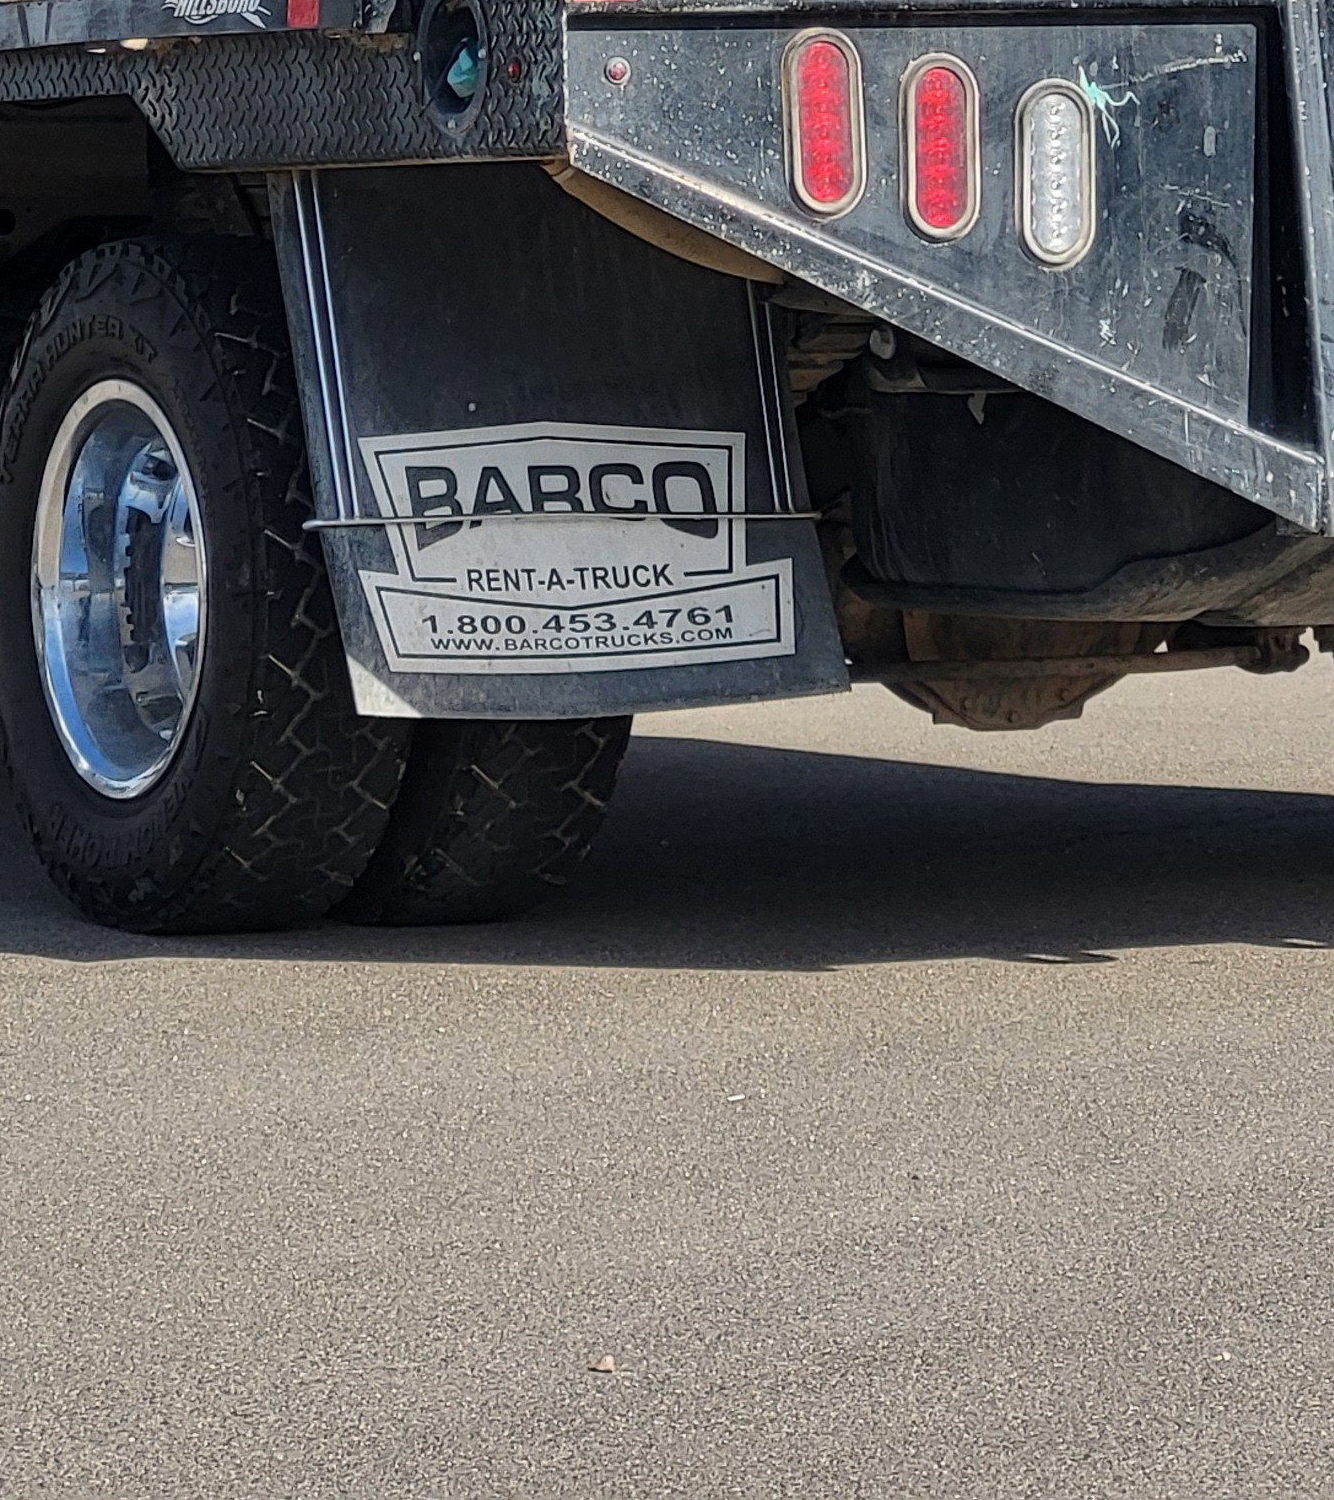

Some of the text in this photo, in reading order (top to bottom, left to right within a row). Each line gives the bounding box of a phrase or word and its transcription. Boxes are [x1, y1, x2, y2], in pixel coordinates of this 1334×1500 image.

[45, 315, 123, 368] HUNTER
[405, 461, 718, 550] BARCO
[467, 564, 674, 592] RENT-A-TRUCK
[421, 604, 735, 636] 1.800.453.4761
[431, 627, 734, 652] WWW.BARCOTRUCKS.COM
